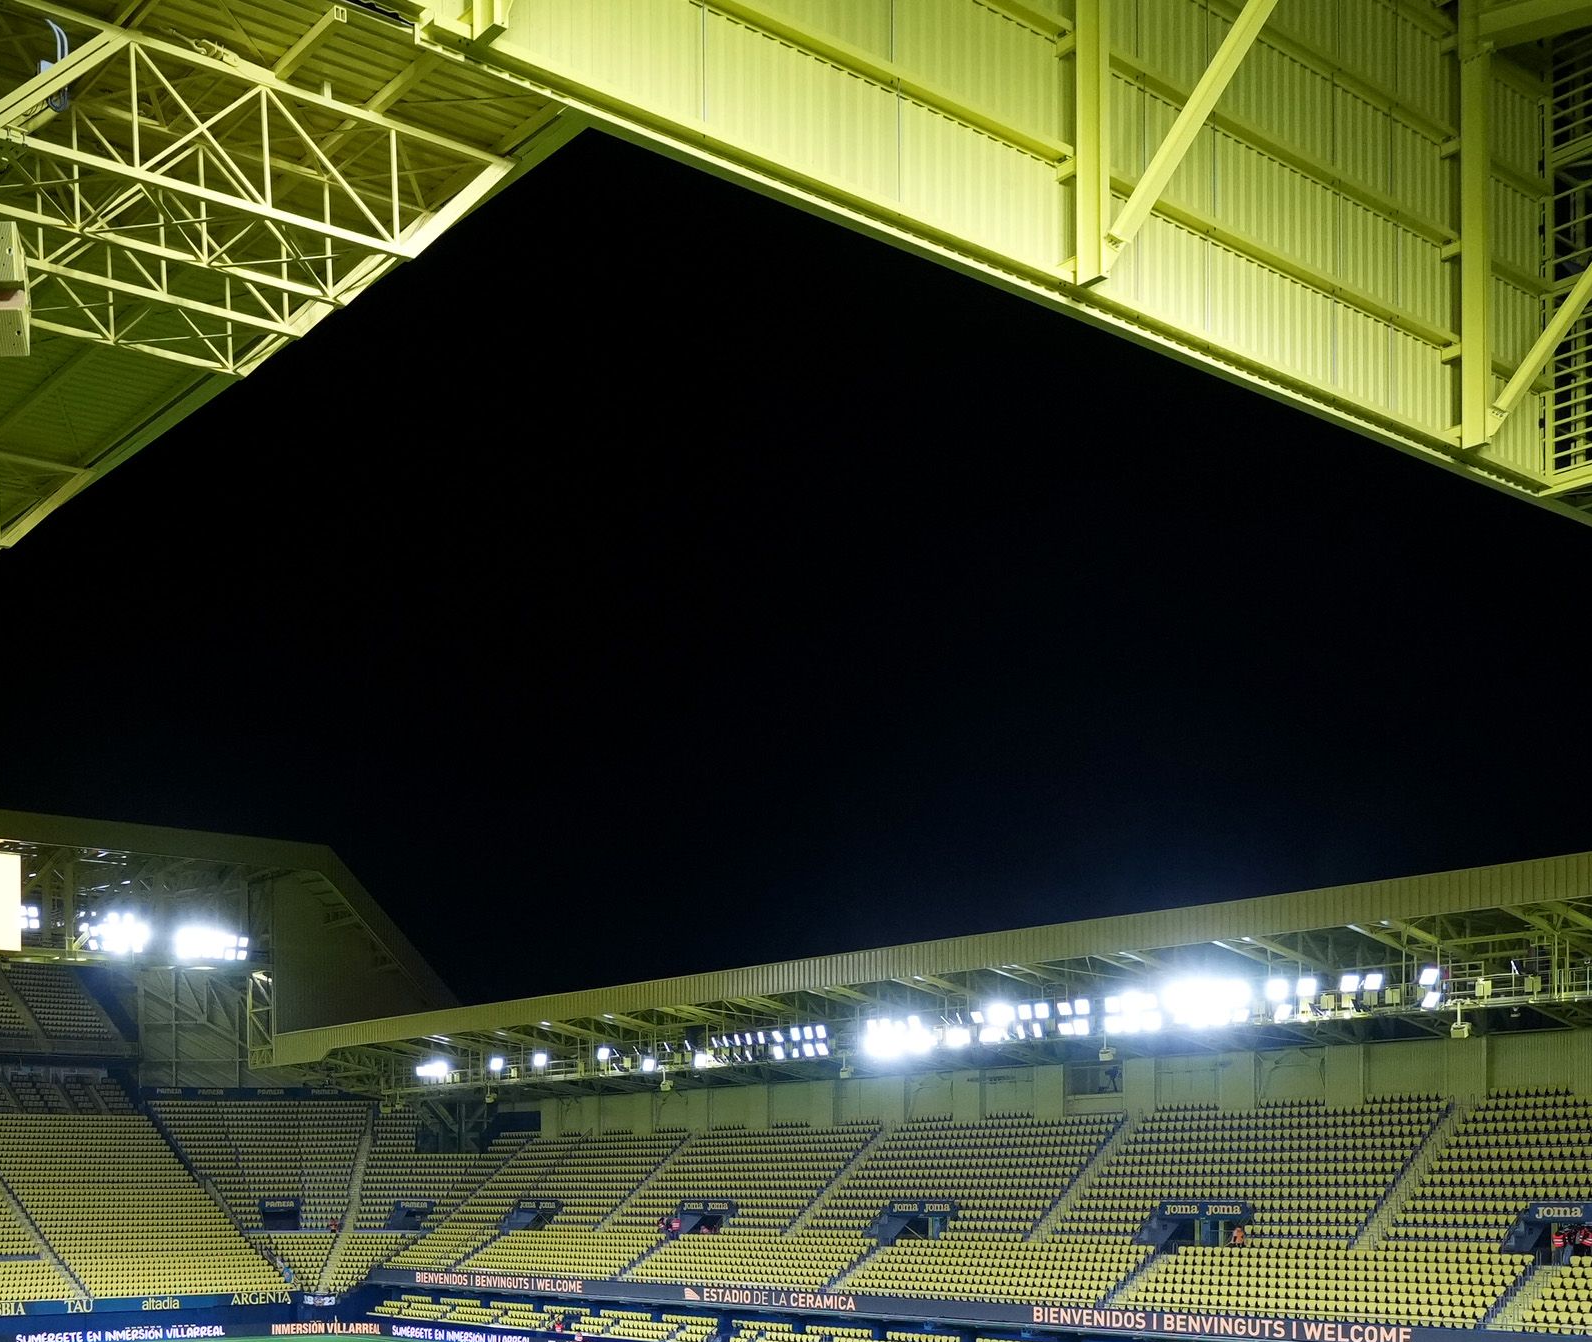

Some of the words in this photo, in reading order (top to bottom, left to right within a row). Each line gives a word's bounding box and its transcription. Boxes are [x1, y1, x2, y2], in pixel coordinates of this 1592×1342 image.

[415, 1272, 468, 1286] BIENVENIDOS
[475, 1277, 529, 1290] BENVINGUTS
[536, 1279, 583, 1293] WELCOME
[141, 1297, 180, 1311] altadia
[231, 1291, 292, 1305] ARGENTA
[703, 1288, 750, 1304] ESTADIO
[753, 1291, 768, 1305] DE
[772, 1292, 787, 1306] LA
[790, 1292, 856, 1311] CERAMICA
[64, 1300, 94, 1313] TAU
[271, 1321, 325, 1335] INMERSIÓN
[326, 1322, 381, 1335] VILLARREAL
[1032, 1306, 1146, 1330] BIENVENIDOS
[1163, 1313, 1285, 1338] BENVINGUTS
[86, 1330, 102, 1342] EN
[166, 1325, 225, 1338] VILLARREAL
[434, 1329, 445, 1340] EN
